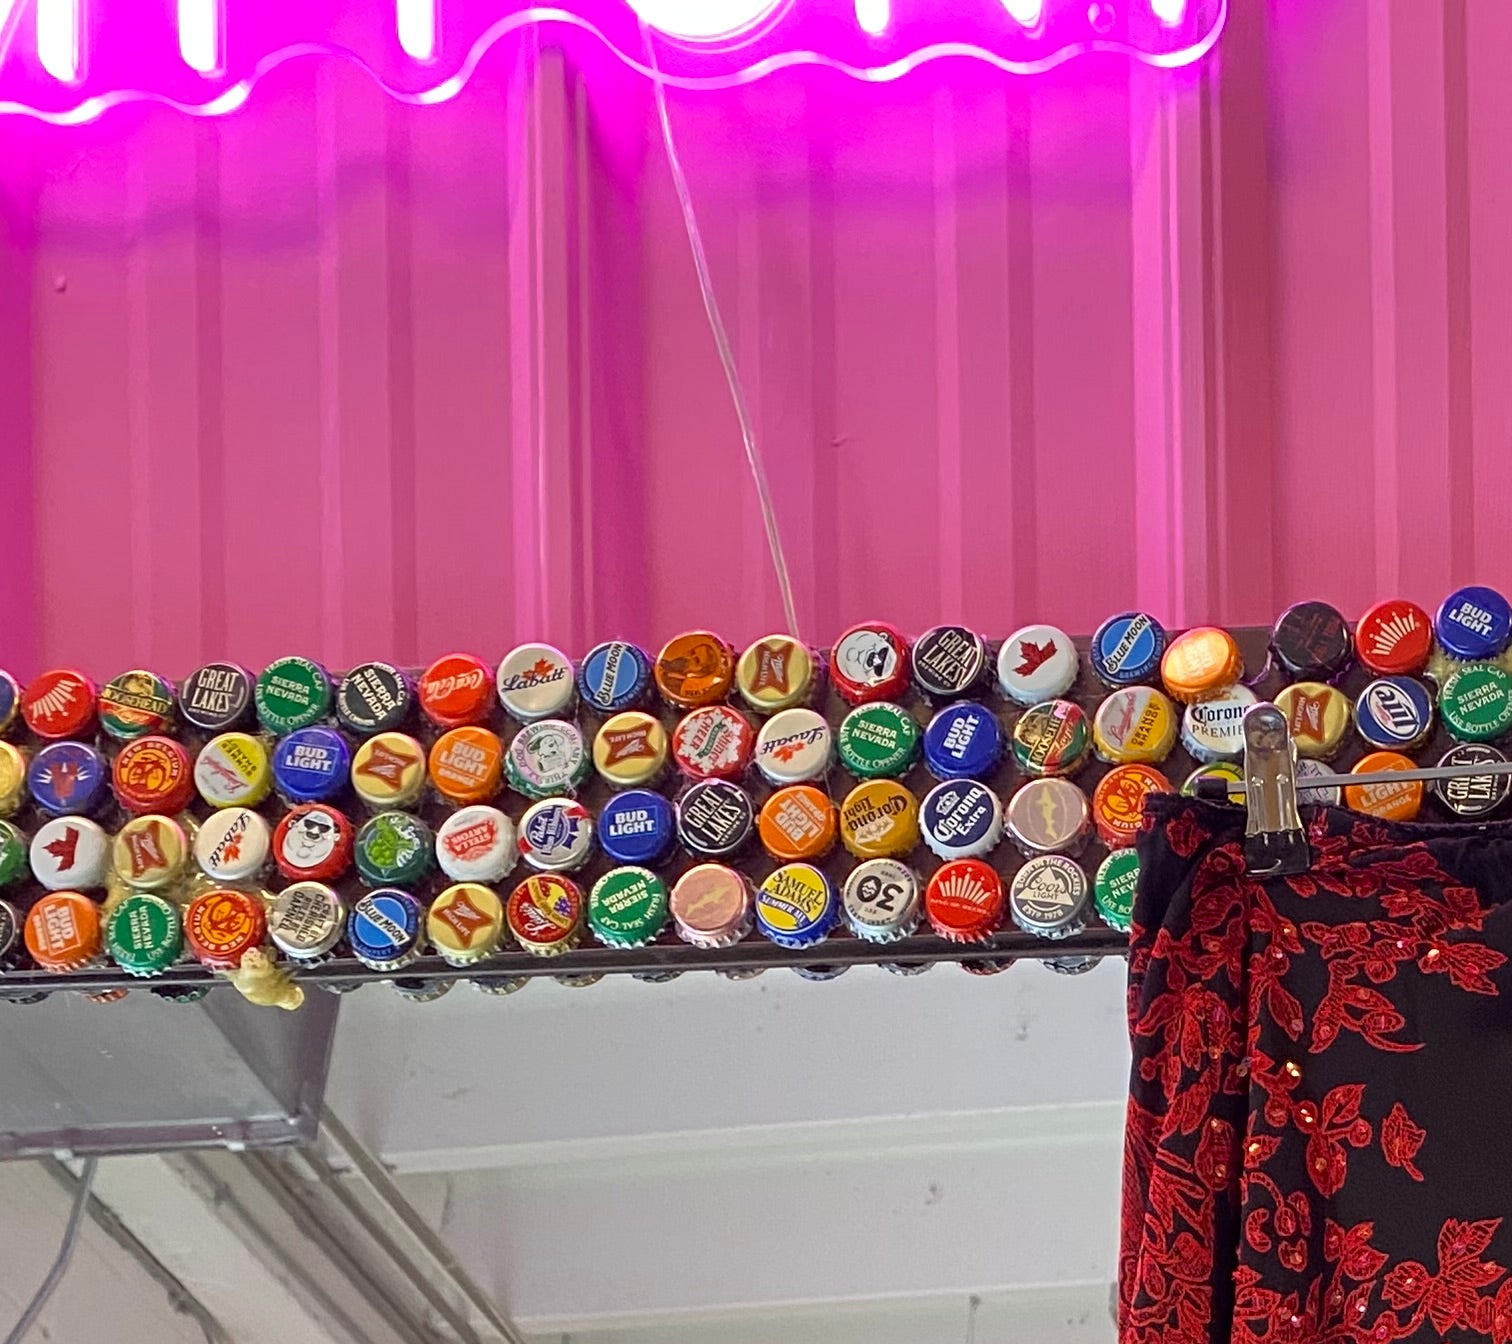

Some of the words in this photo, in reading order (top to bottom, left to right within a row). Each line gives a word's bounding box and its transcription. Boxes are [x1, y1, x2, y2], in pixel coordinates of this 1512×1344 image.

[1449, 609, 1492, 637] LIGHT
[1460, 602, 1493, 623] BUD
[938, 629, 977, 667] GREAT
[1106, 643, 1128, 673] BLUE
[1126, 615, 1148, 645] MOON
[597, 671, 615, 703] BLUE
[608, 644, 623, 674] MOON
[922, 645, 966, 683] LAKES
[1462, 665, 1484, 675] SEAL
[1487, 665, 1506, 680] CAP
[198, 668, 240, 693] GREAT
[270, 676, 310, 694] SIERRA
[363, 668, 397, 711] SIERRA
[501, 667, 567, 692] Labatt
[191, 687, 233, 713] LAKES
[266, 685, 309, 706] NEVADA
[351, 673, 388, 721] NEVADA
[1457, 682, 1498, 704] SIERRA
[1459, 690, 1505, 715] NEVADA
[257, 702, 286, 725] BOTTLE
[1450, 711, 1463, 729] USE
[1465, 722, 1499, 733] BOTTLE
[690, 716, 713, 750] CHEER
[760, 725, 827, 755] Labatt
[852, 728, 896, 749] NEVADA
[858, 719, 898, 738] SIERRA
[943, 717, 966, 751] BUD
[951, 714, 980, 759] LIGHT
[121, 742, 143, 766] NEW
[146, 741, 180, 778] BELGIUM
[285, 755, 333, 772] LIGHT
[294, 745, 328, 760] BUD
[440, 752, 488, 775] LIGHT
[452, 742, 486, 761] BUD
[842, 743, 871, 767] BOTTLE
[614, 810, 648, 824] BUD
[684, 786, 724, 829] GREAT
[778, 800, 820, 839] LIGHT
[844, 795, 874, 820] Light
[848, 794, 908, 832] Corona
[933, 786, 986, 842] Corona
[956, 805, 987, 836] Extra
[450, 824, 488, 844] ARTOIS
[530, 816, 547, 844] Pabst
[609, 820, 655, 837] LIGHT
[701, 800, 742, 842] LAKES
[775, 811, 805, 842] BUD
[209, 811, 251, 871] Labatt
[454, 832, 492, 851] STELLA
[772, 870, 824, 905] SAMUEL
[1027, 877, 1068, 895] Coors
[1062, 861, 1080, 896] ROCKIES
[601, 880, 647, 906] NEVADA
[608, 890, 648, 914] SIERRA
[760, 893, 795, 916] SUMMER
[772, 884, 814, 913] ADAMS
[1033, 891, 1059, 901] LIGHT
[44, 904, 65, 951] LIGHT
[58, 905, 75, 940] BUD
[129, 909, 143, 951] SIERRA
[138, 904, 154, 950] NEVADA
[192, 904, 217, 951] BELGIUM
[357, 898, 382, 924] BLUE
[378, 917, 406, 945] MOON
[600, 916, 619, 930] CAP
[622, 917, 644, 930] SEAL
[220, 935, 244, 951] NEW
